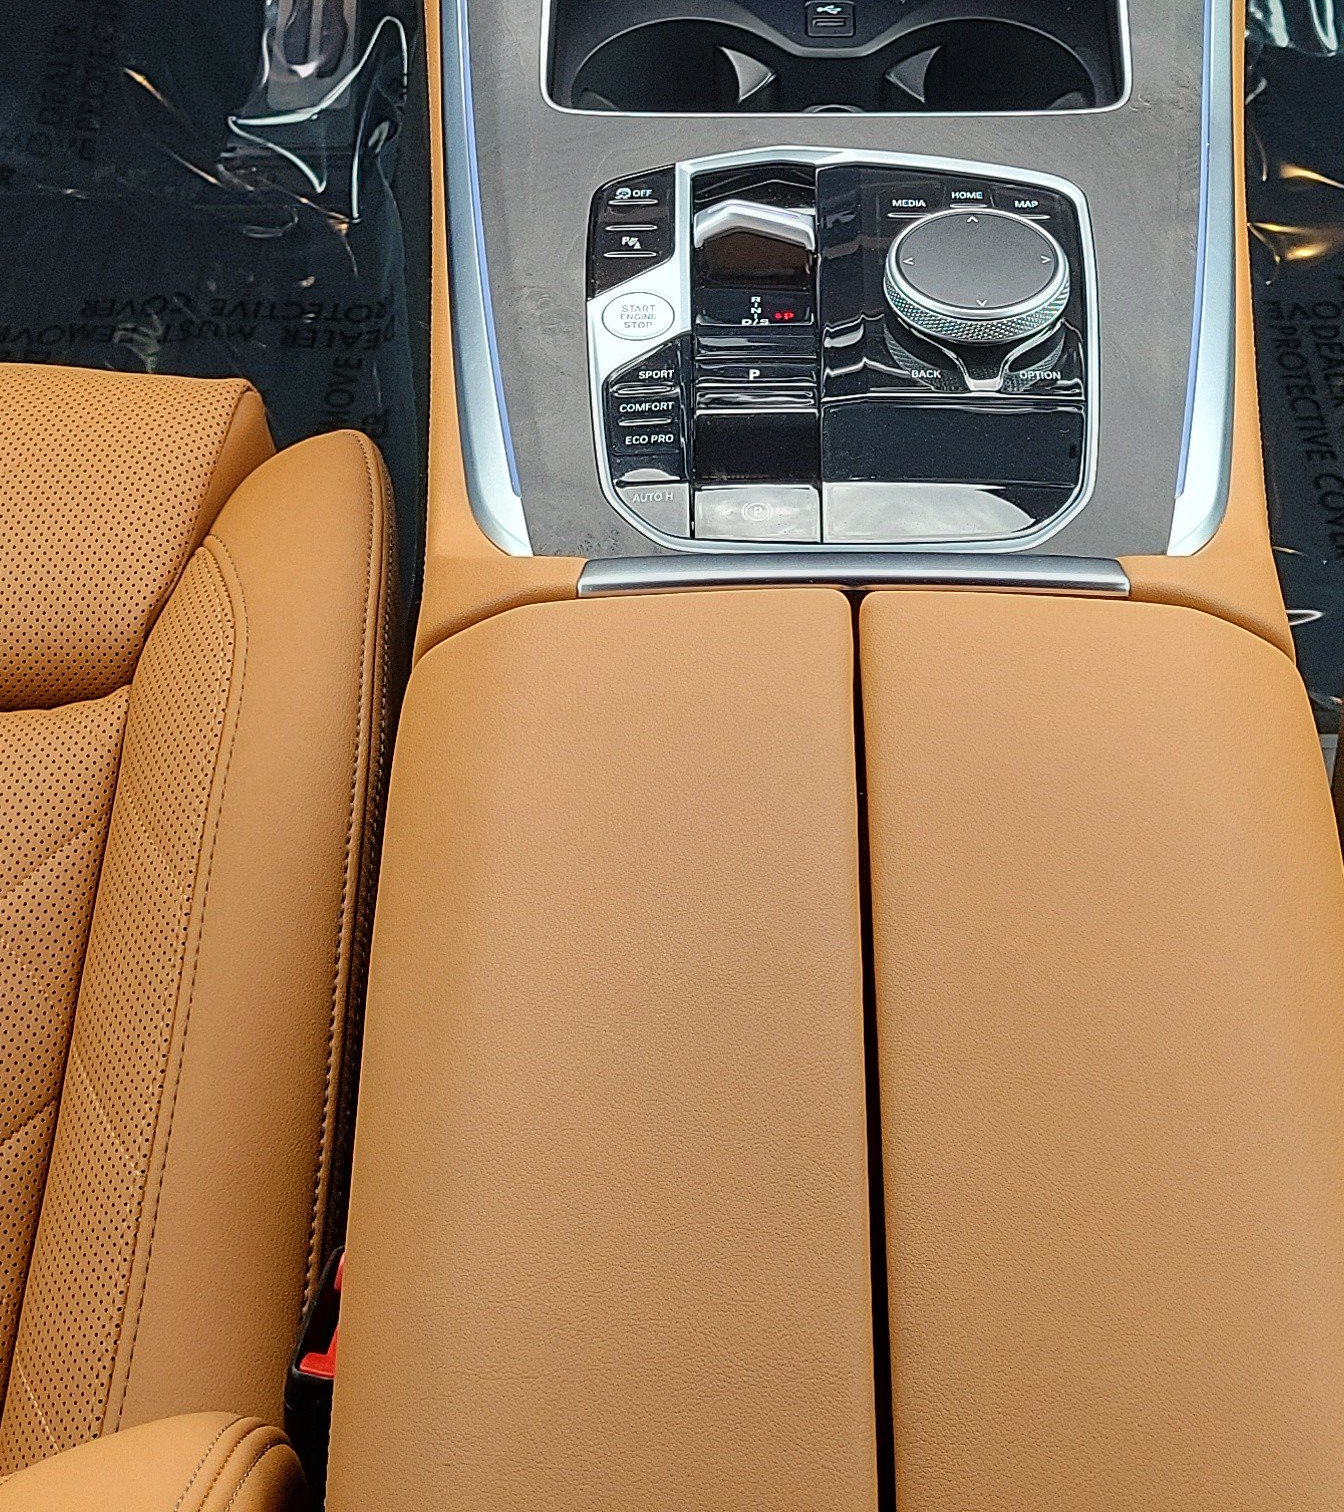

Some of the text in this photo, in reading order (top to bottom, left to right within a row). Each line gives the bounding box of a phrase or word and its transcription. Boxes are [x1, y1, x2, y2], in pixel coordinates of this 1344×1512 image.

[632, 188, 653, 198] OFF
[951, 191, 984, 200] HOME
[891, 199, 927, 208] MEDIA
[1014, 200, 1039, 209] MAP
[621, 304, 656, 313] START
[620, 313, 657, 321] ENGINE
[623, 321, 654, 330] STOP
[638, 369, 675, 380] SPORT
[749, 369, 761, 381] P
[911, 369, 942, 379] BACK
[1019, 370, 1062, 381] OPTION
[1272, 323, 1338, 463] PROTECTIVE
[619, 401, 675, 413] COMFORT
[625, 434, 674, 445] ECO PRO
[632, 491, 674, 503] AUTO H
